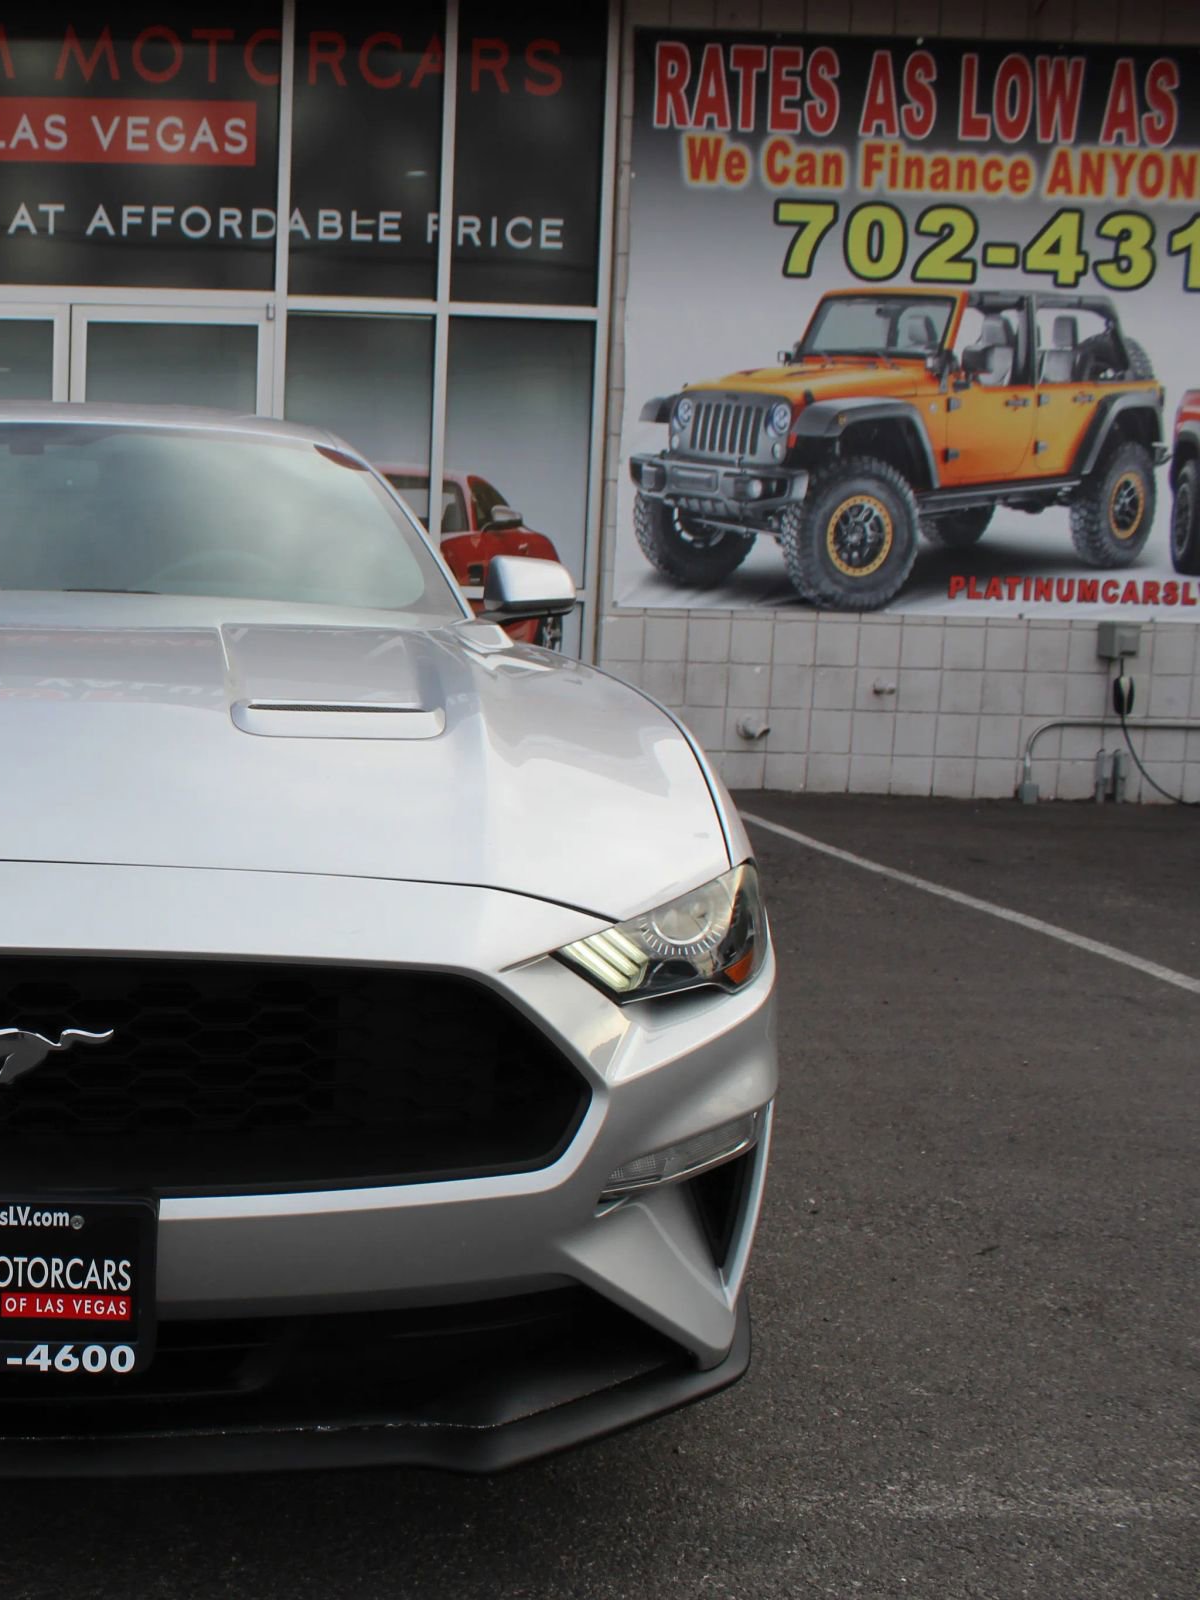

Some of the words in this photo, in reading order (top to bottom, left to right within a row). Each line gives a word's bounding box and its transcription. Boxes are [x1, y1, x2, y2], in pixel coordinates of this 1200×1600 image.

[54, 23, 564, 96] MOTORCARS
[654, 41, 841, 137] RATES
[859, 50, 937, 140] AS
[958, 54, 1086, 143] LOW
[1101, 57, 1179, 147] AS
[92, 115, 249, 154] VEGAS
[686, 135, 748, 184] We
[764, 139, 845, 188] Can
[861, 143, 1032, 194] Finance
[8, 203, 65, 235] AT
[86, 204, 402, 242] AFFORDABLE
[947, 575, 1200, 606] PLATINUMCARSL
[5, 1297, 27, 1312] OF
[36, 1298, 65, 1313] LAS
[73, 1299, 127, 1315] VEGAS
